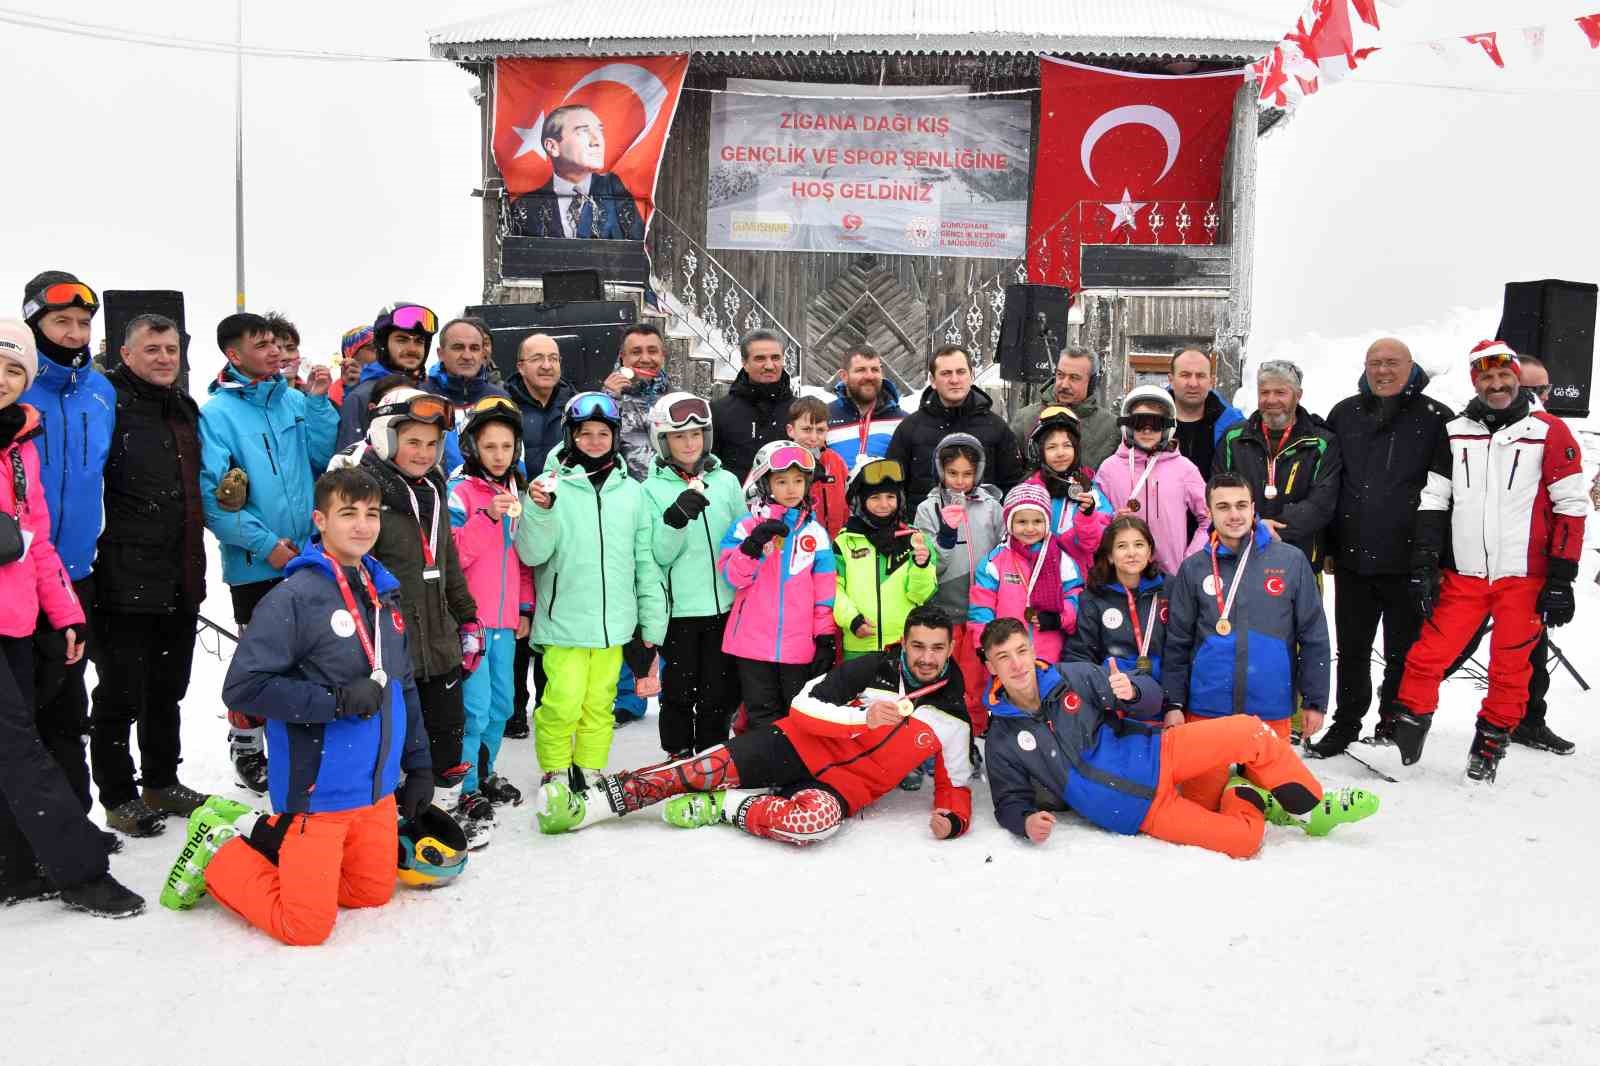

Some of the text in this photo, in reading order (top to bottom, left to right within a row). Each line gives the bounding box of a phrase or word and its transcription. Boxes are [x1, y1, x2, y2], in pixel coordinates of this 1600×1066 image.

[863, 113, 912, 132] DAĞI
[720, 144, 1009, 170] GENÇLİK VE SPOR ŞENLİĞİNE
[791, 181, 933, 202] HOŞ GELDİNİZ
